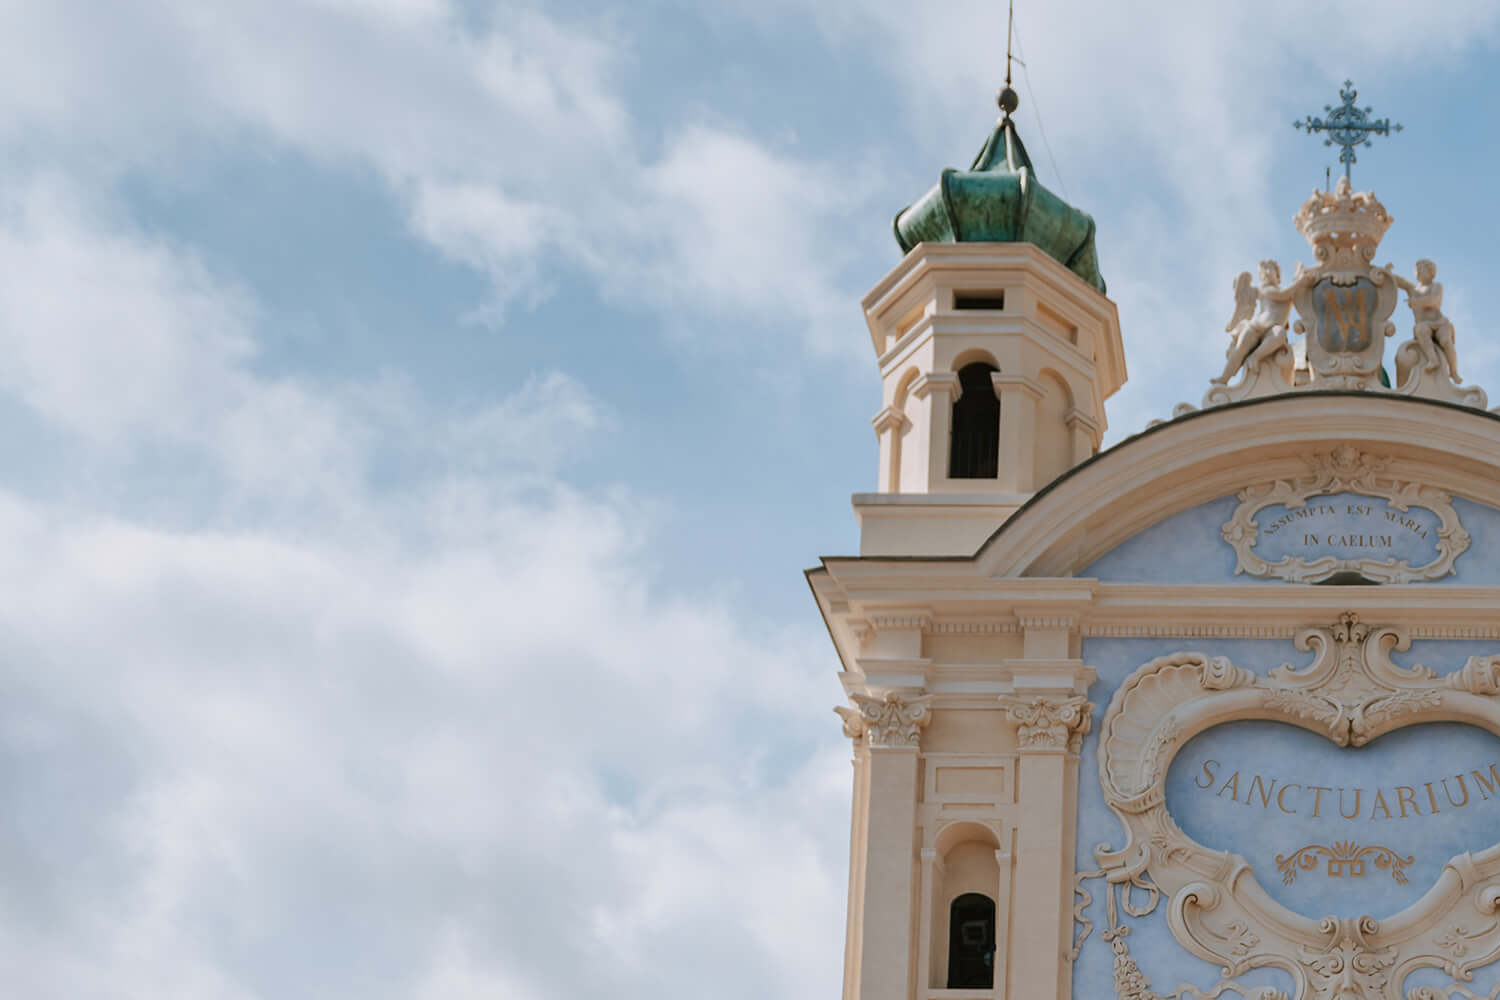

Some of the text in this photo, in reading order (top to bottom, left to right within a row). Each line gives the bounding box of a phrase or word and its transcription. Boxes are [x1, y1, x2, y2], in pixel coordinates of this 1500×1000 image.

[1263, 504, 1429, 540] ASSUMPTA EST MARIA
[1303, 534, 1393, 547] IN CAELUM
